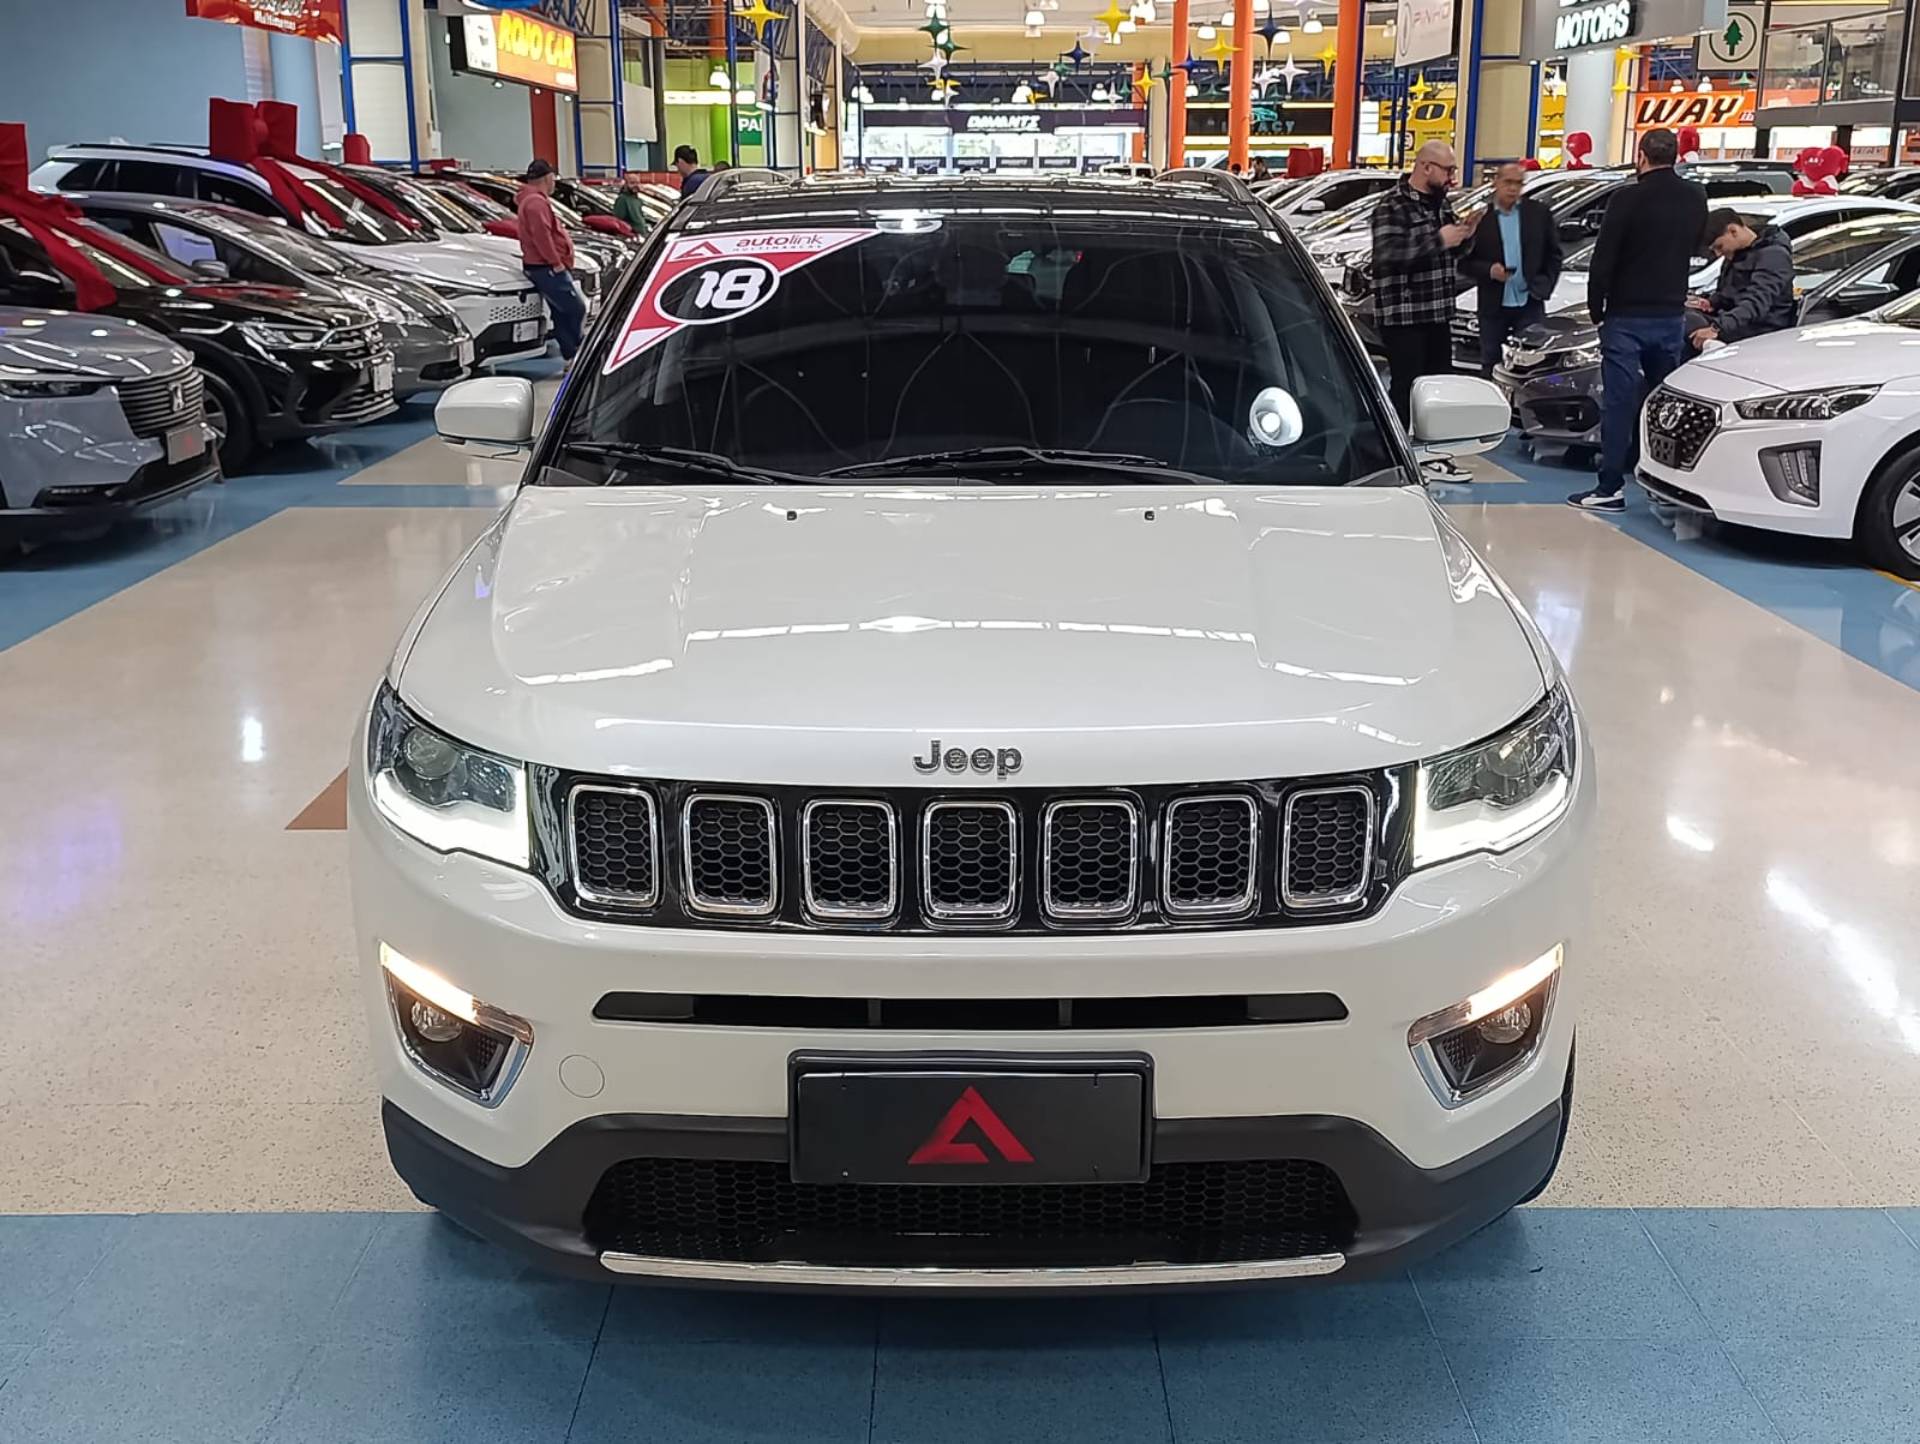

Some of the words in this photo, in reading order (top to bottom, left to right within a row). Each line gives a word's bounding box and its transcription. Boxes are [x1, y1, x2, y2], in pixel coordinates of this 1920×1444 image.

[1554, 0, 1631, 50] MOTORS
[544, 30, 574, 70] CAR
[1636, 95, 1745, 127] WAY
[735, 234, 823, 248] autolink
[694, 267, 767, 310] 18
[912, 739, 1023, 780] Jeep
